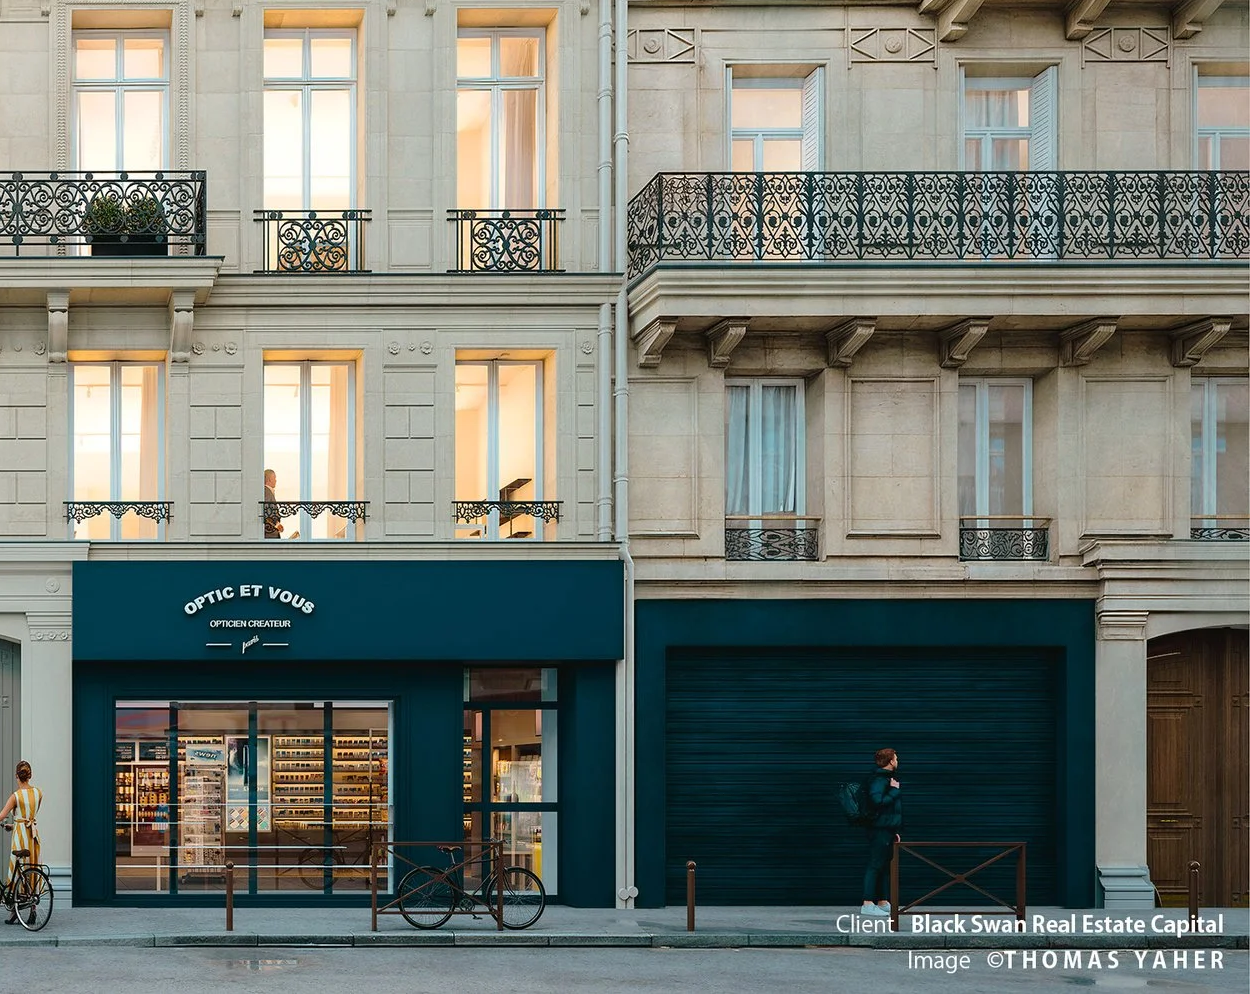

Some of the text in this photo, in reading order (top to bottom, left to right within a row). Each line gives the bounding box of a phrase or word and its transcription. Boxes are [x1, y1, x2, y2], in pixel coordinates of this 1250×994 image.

[183, 584, 315, 615] OPTIC ET VOUS
[209, 619, 291, 628] OPTICIEN CREATEUR
